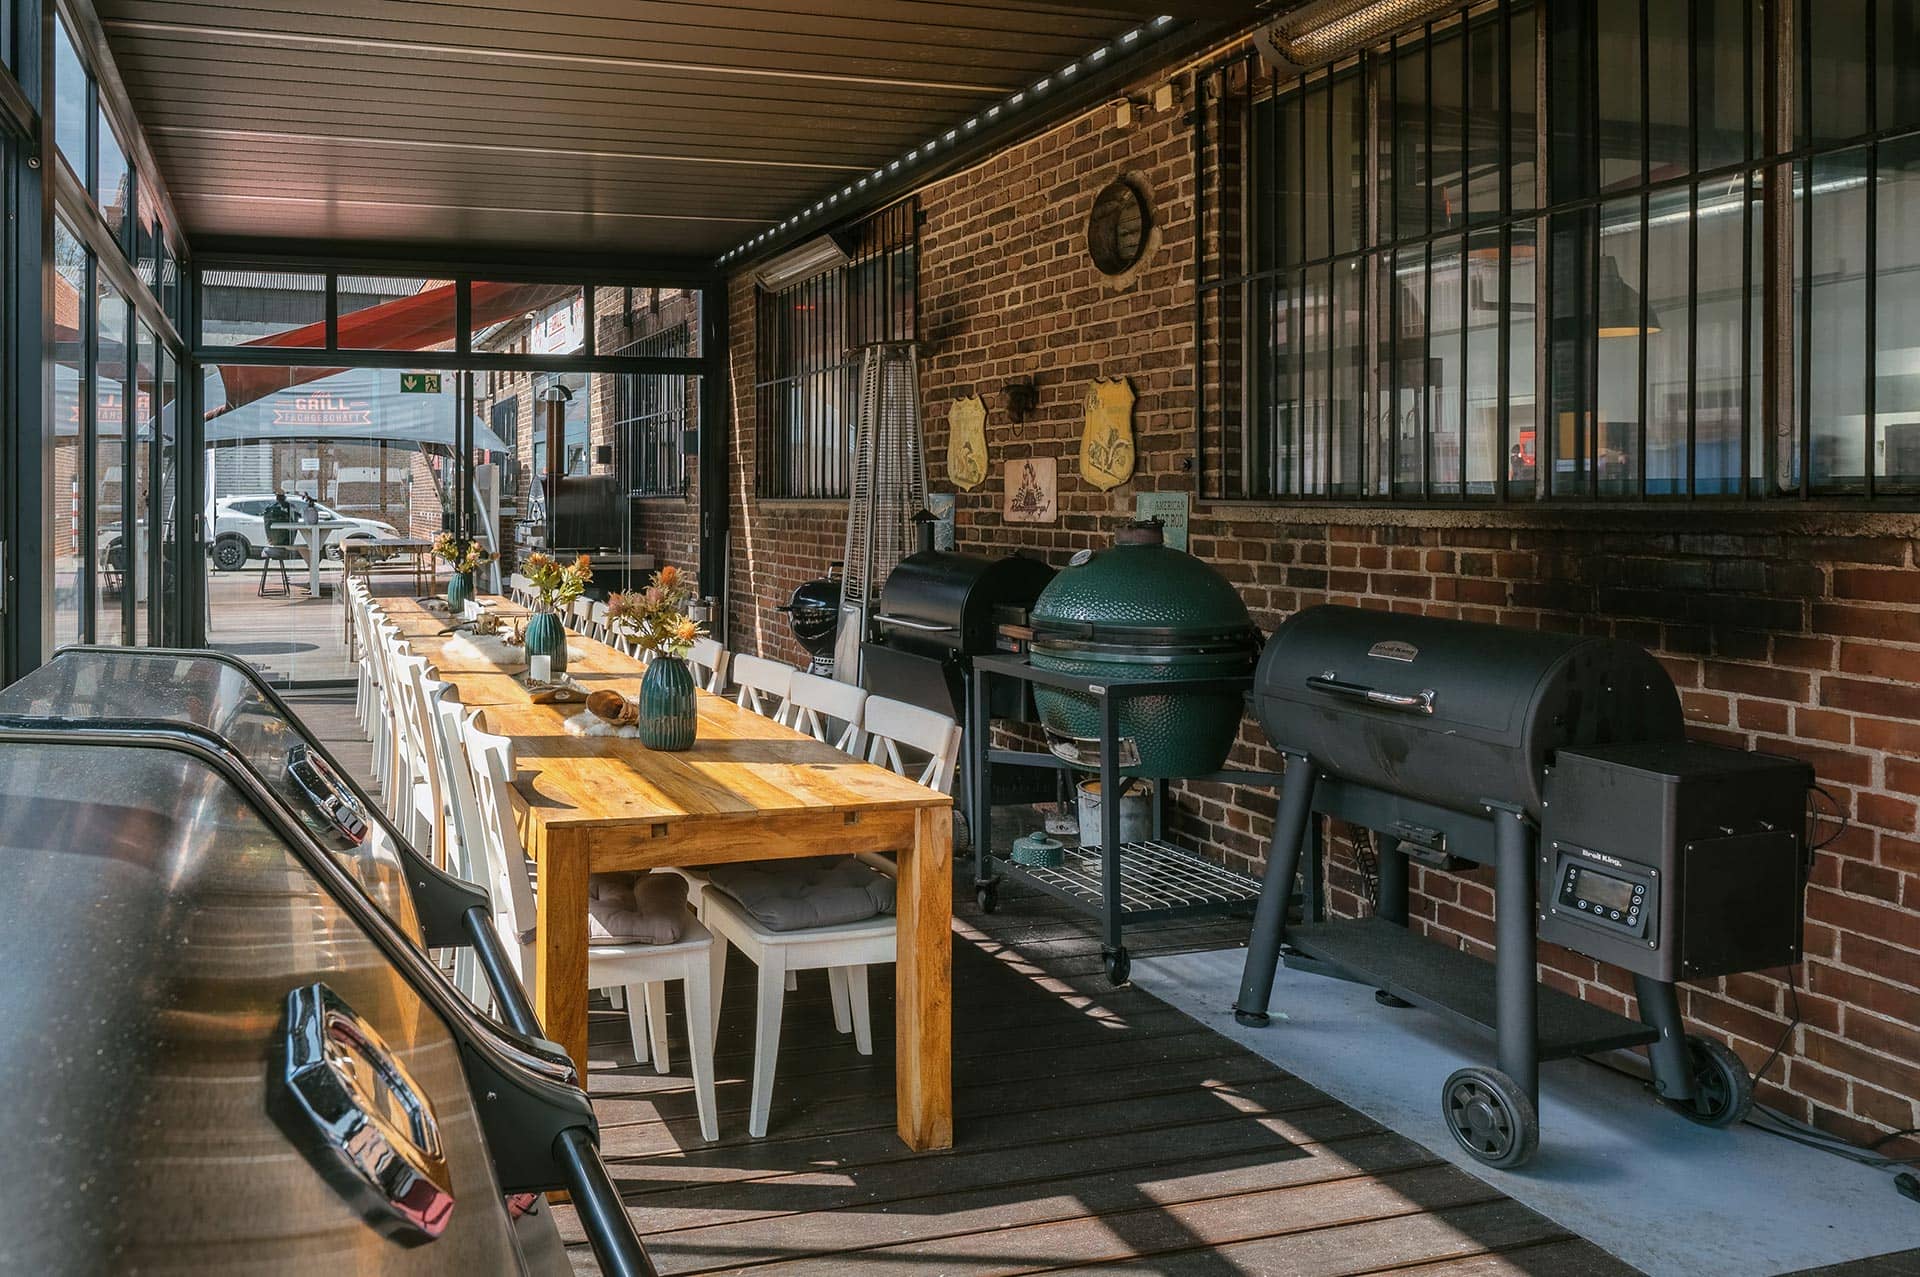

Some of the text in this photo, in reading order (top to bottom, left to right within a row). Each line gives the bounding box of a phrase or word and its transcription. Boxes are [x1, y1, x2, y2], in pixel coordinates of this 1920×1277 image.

[295, 398, 350, 410] GRILL
[1156, 500, 1185, 510] AMERICAN
[1582, 849, 1601, 860] Broil
